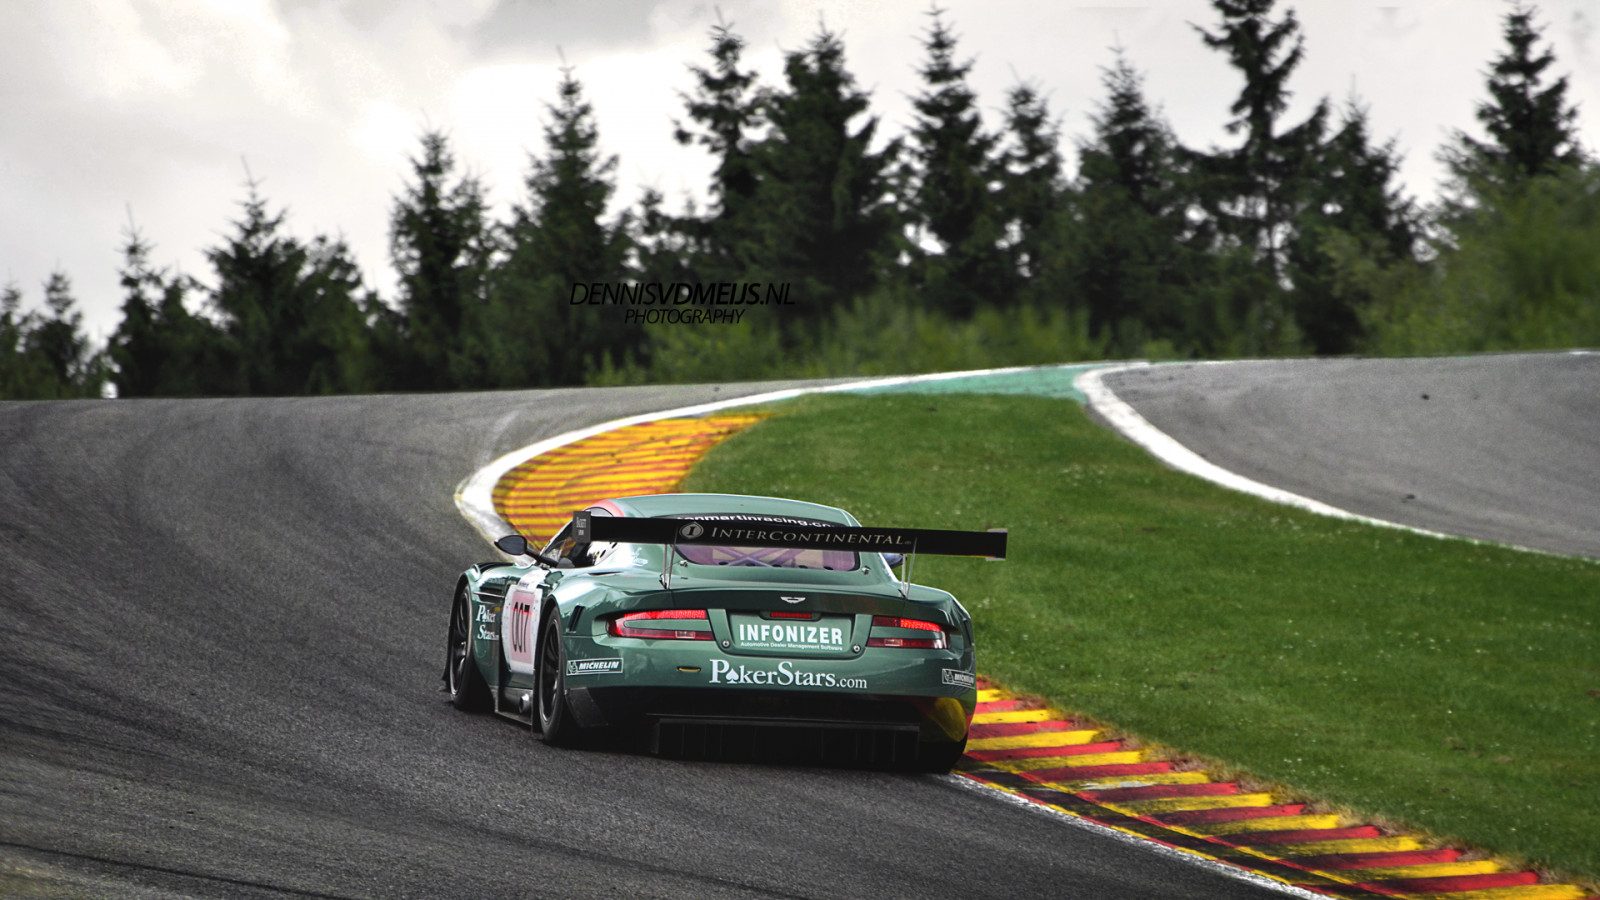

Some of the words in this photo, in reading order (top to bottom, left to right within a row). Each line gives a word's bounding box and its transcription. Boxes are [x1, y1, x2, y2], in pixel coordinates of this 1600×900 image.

[711, 527, 904, 545] INTERCONTINENTAL
[512, 601, 530, 653] 007
[739, 624, 843, 645] INFONIZER
[787, 643, 820, 651] Management
[579, 661, 619, 670] MICHELIN
